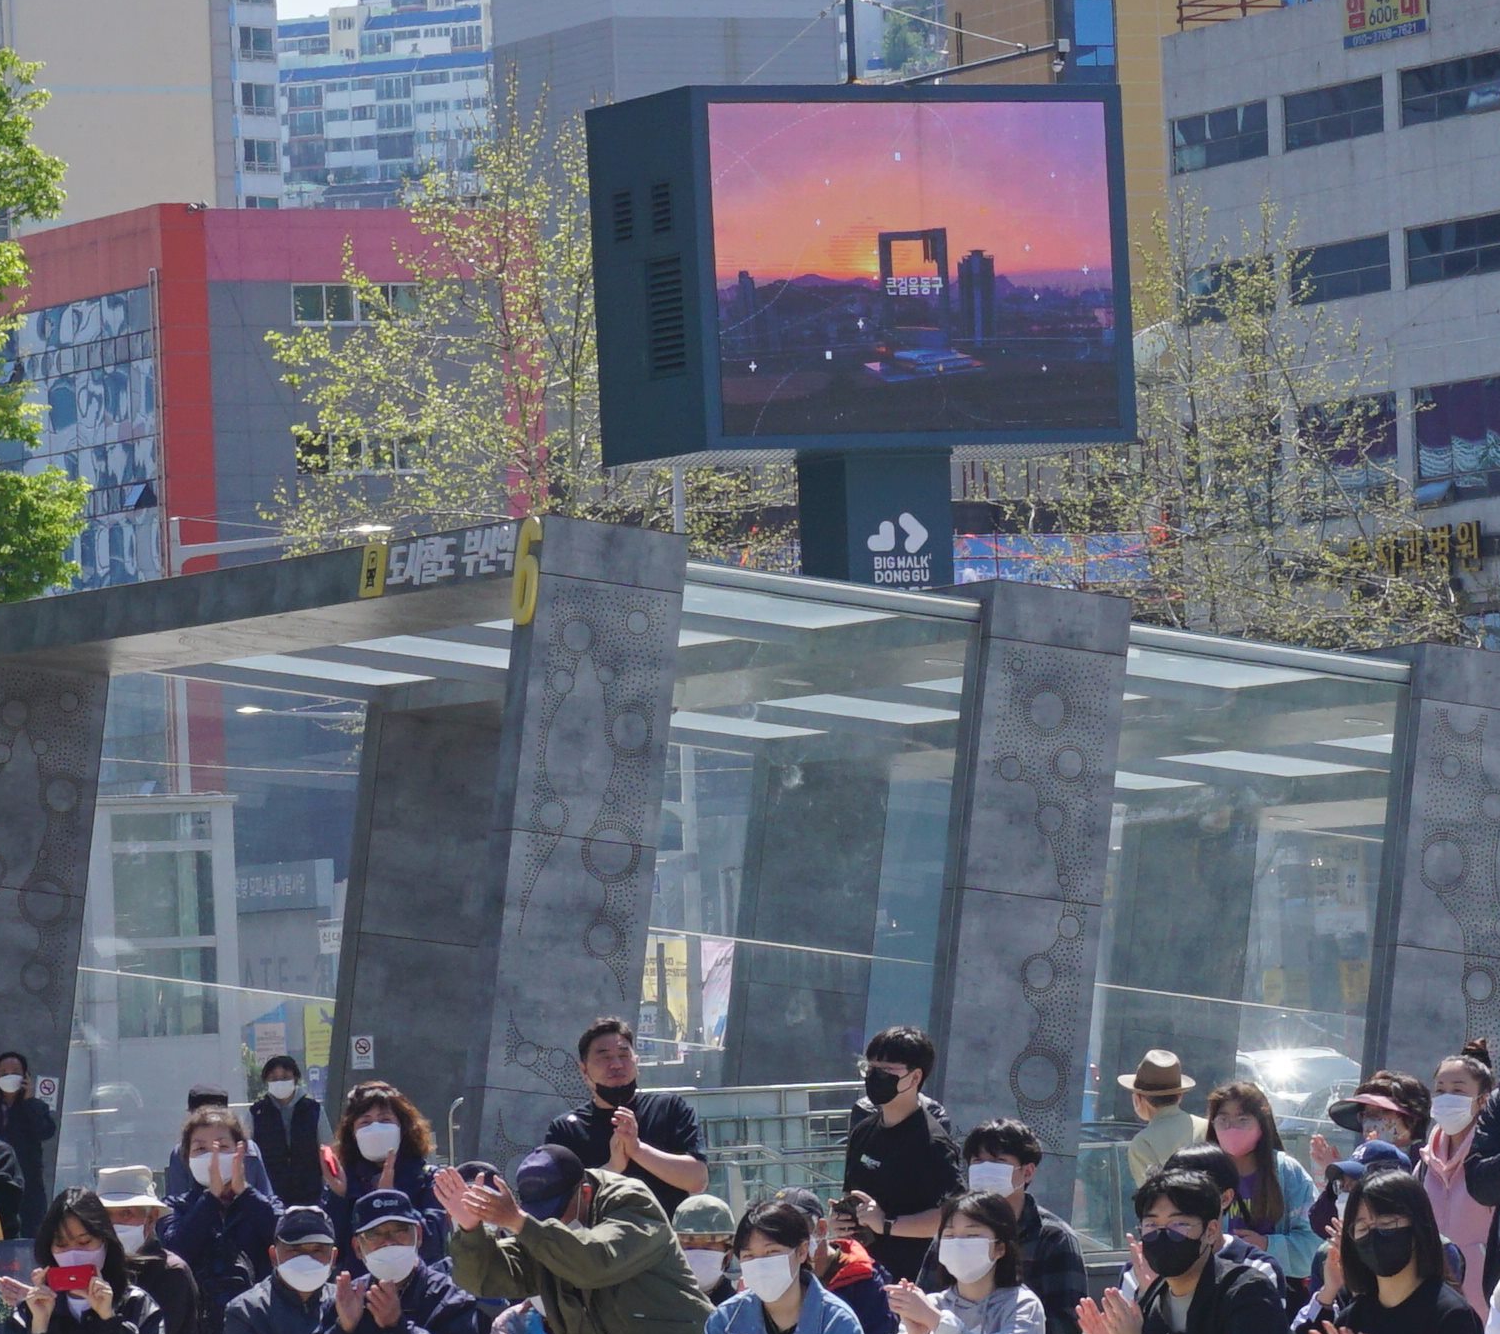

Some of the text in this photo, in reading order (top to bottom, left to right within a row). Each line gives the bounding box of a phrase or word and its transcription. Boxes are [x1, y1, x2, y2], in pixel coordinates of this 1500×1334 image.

[886, 276, 944, 295] 큰걸음동구
[386, 523, 517, 586] 도시철도 부산역
[512, 517, 543, 626] 6
[874, 556, 896, 570] BIG
